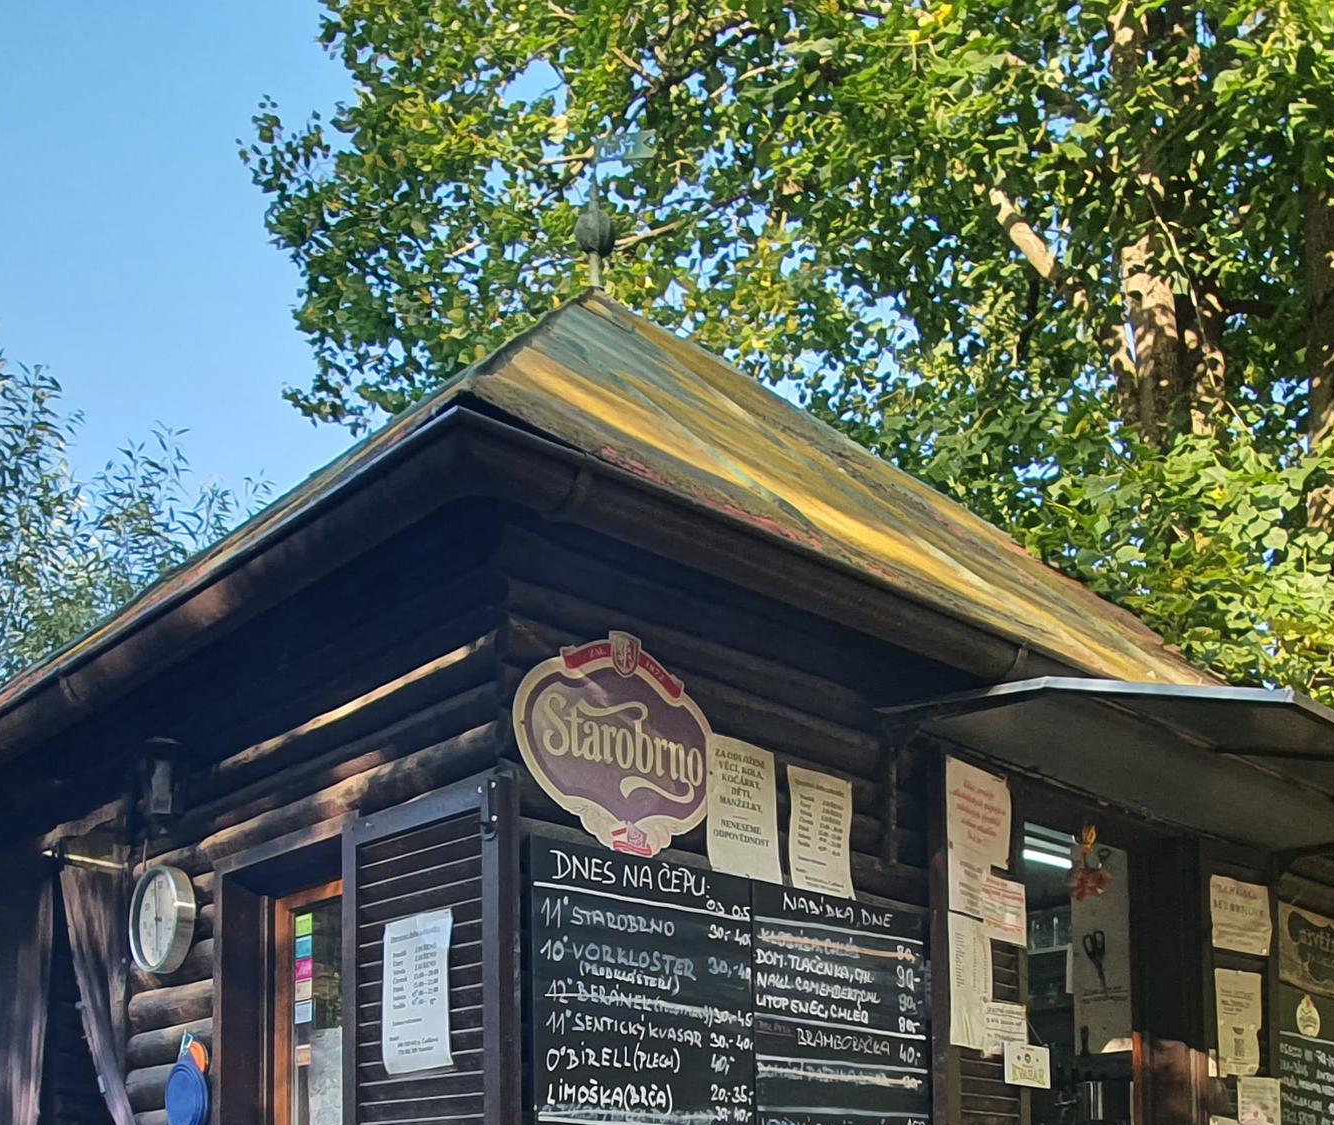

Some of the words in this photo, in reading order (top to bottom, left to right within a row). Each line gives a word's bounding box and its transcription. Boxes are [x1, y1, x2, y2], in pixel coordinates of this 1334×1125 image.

[541, 693, 704, 798] Starobrno
[713, 829, 769, 847] ODPOVĚDNOST
[721, 819, 761, 835] NENESEME
[550, 850, 616, 884] DNES
[623, 865, 653, 890] NA
[570, 906, 675, 937] STAROBRNO
[861, 908, 893, 927] DNE
[572, 942, 696, 981] VORKLOSTER
[649, 1023, 703, 1048] KVASAR
